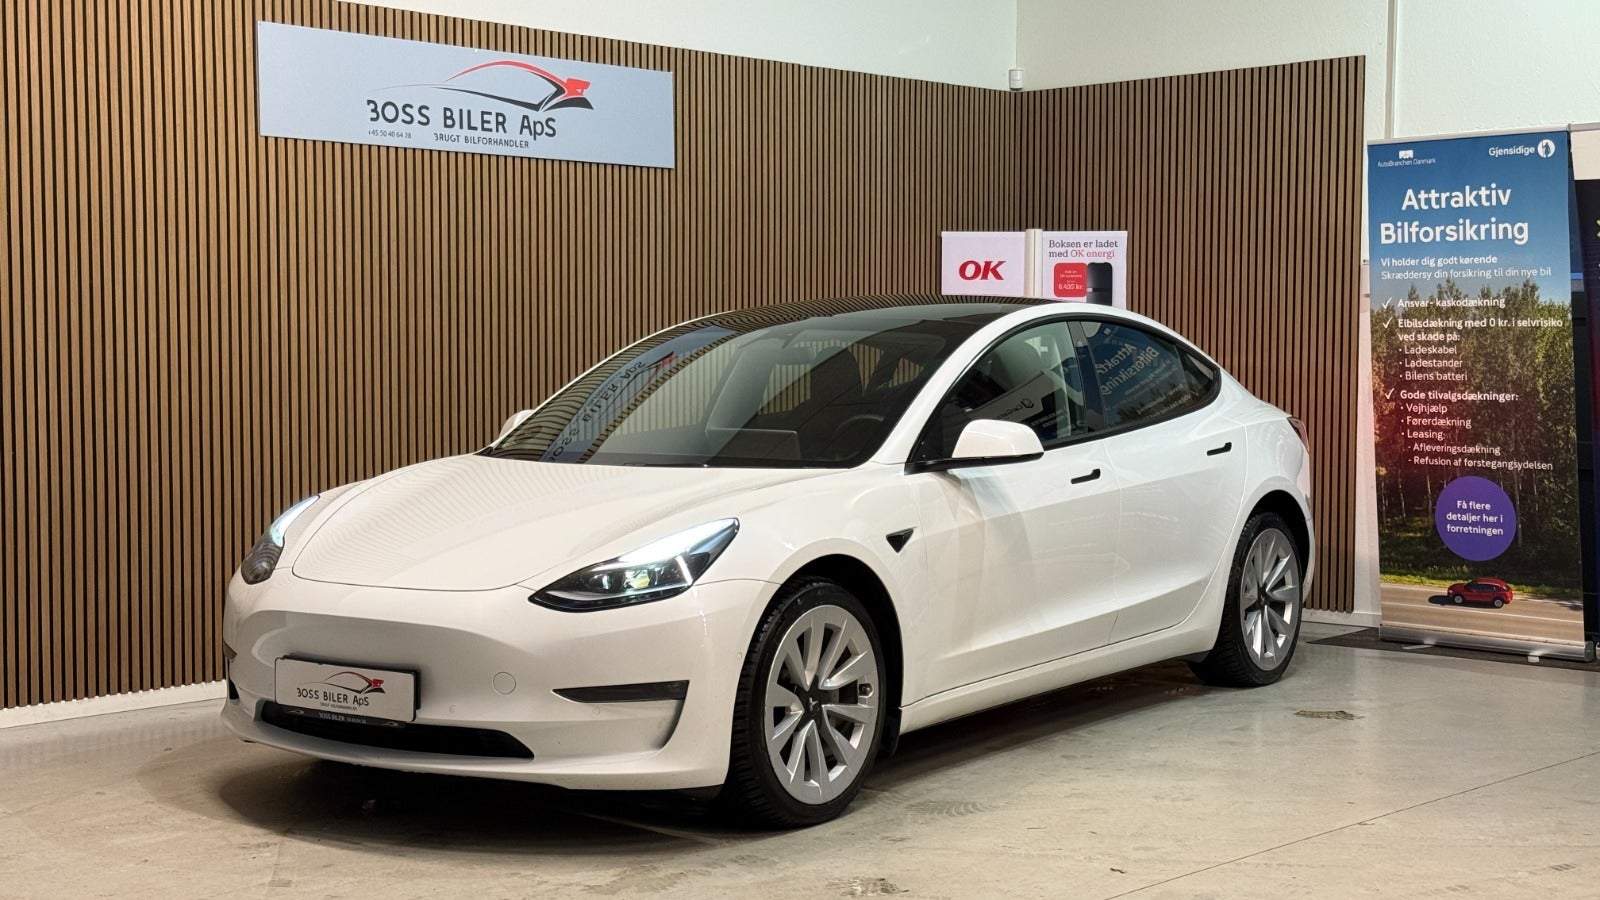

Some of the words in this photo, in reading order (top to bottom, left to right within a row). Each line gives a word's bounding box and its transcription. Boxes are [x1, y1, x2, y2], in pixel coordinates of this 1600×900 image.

[443, 107, 507, 134] BILER
[519, 114, 557, 141] ApS
[464, 135, 529, 149] BILFORHANDLER
[1489, 145, 1535, 157] Gjensidige
[1401, 182, 1512, 211] Attraktiv
[1380, 217, 1529, 245] Bilforsikring
[1049, 240, 1081, 248] Boksen
[1095, 240, 1118, 248] ladet
[1049, 249, 1069, 257] med
[1070, 249, 1085, 257] OK
[1086, 249, 1115, 259] energi
[1381, 258, 1390, 267] Vi
[1391, 257, 1419, 266] holder
[1421, 256, 1436, 267] dig
[1437, 255, 1458, 267] godt
[1459, 255, 1498, 264] kørende
[958, 260, 1006, 280] OK
[1381, 271, 1431, 281] Skræddersy
[1434, 270, 1448, 279] din
[1450, 269, 1492, 279] forsikring
[1494, 268, 1503, 276] til
[1505, 268, 1519, 276] din
[1521, 269, 1537, 277] nye
[1540, 267, 1551, 275] bil
[1398, 299, 1434, 308] Ansvar-
[1436, 298, 1505, 308] kaskodækning
[1398, 318, 1463, 328] Elbilsdækning
[1464, 318, 1487, 327] med
[1489, 318, 1496, 327] 0
[1498, 318, 1511, 327] kr.
[1517, 318, 1563, 327] selvrisiko
[1399, 332, 1415, 341] ved
[1416, 332, 1444, 341] skade
[1446, 331, 1460, 343] på:
[1404, 345, 1457, 355] Ladeskabel
[1404, 358, 1463, 368] Ladestander
[1405, 372, 1434, 381] Bilens
[1436, 372, 1468, 381] batteri
[1400, 390, 1426, 400] Gode
[1428, 390, 1519, 403] tilvalgsdækninger:
[1406, 403, 1448, 414] Vejhjælp
[1406, 416, 1472, 429] Førerdækning
[1413, 444, 1501, 456] Afleveringsdækning
[1414, 456, 1452, 467] Refusion
[1453, 458, 1462, 466] af
[1464, 458, 1553, 471] førstegangsydelsen
[1457, 500, 1467, 509] Få
[1469, 500, 1491, 510] flere
[1446, 512, 1481, 523] detaljer
[1482, 513, 1498, 522] her
[1446, 524, 1504, 536] forretningen
[323, 691, 348, 703] BILER
[352, 695, 369, 707] ApS
